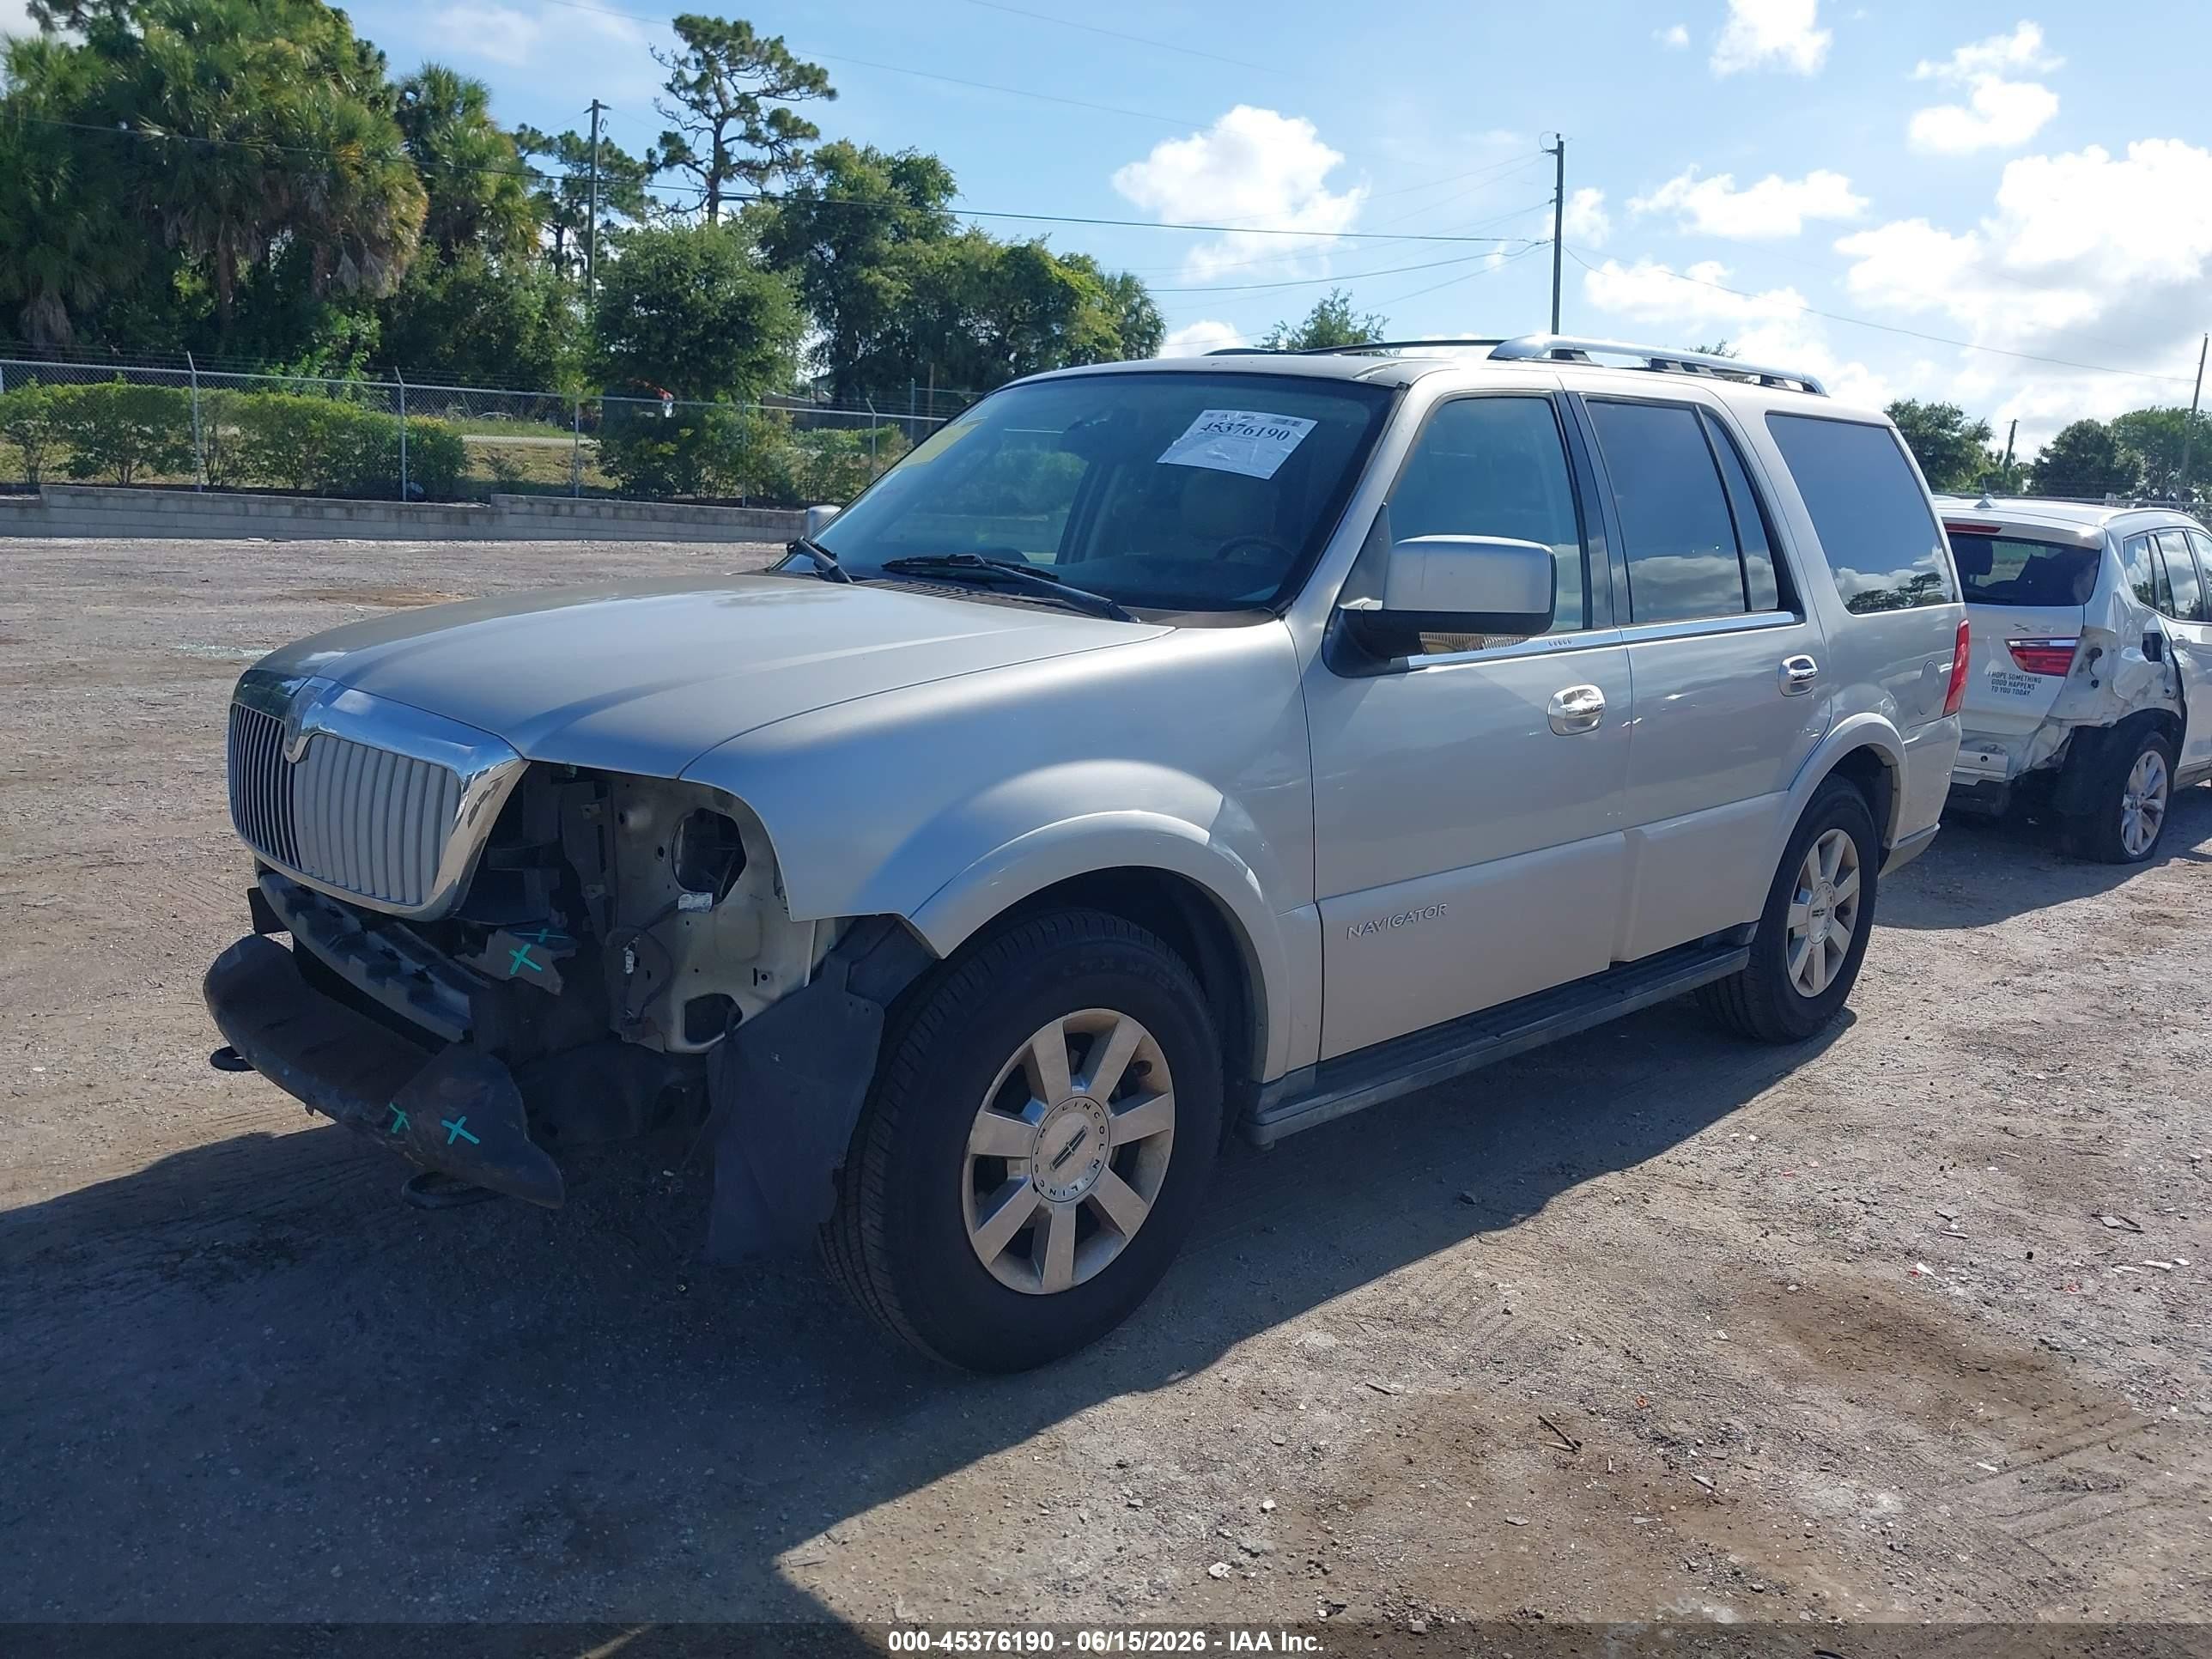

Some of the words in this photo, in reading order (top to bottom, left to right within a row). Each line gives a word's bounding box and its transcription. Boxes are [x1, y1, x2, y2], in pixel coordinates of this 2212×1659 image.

[2000, 686, 2011, 695] YOU
[2008, 673, 2042, 684] SOMETHING
[2008, 681, 2035, 690] HAPPENS
[1346, 902, 1449, 940] NAVIGATOR
[1061, 1101, 1106, 1170] LINCOLN
[1034, 1127, 1079, 1197] LINCOLN
